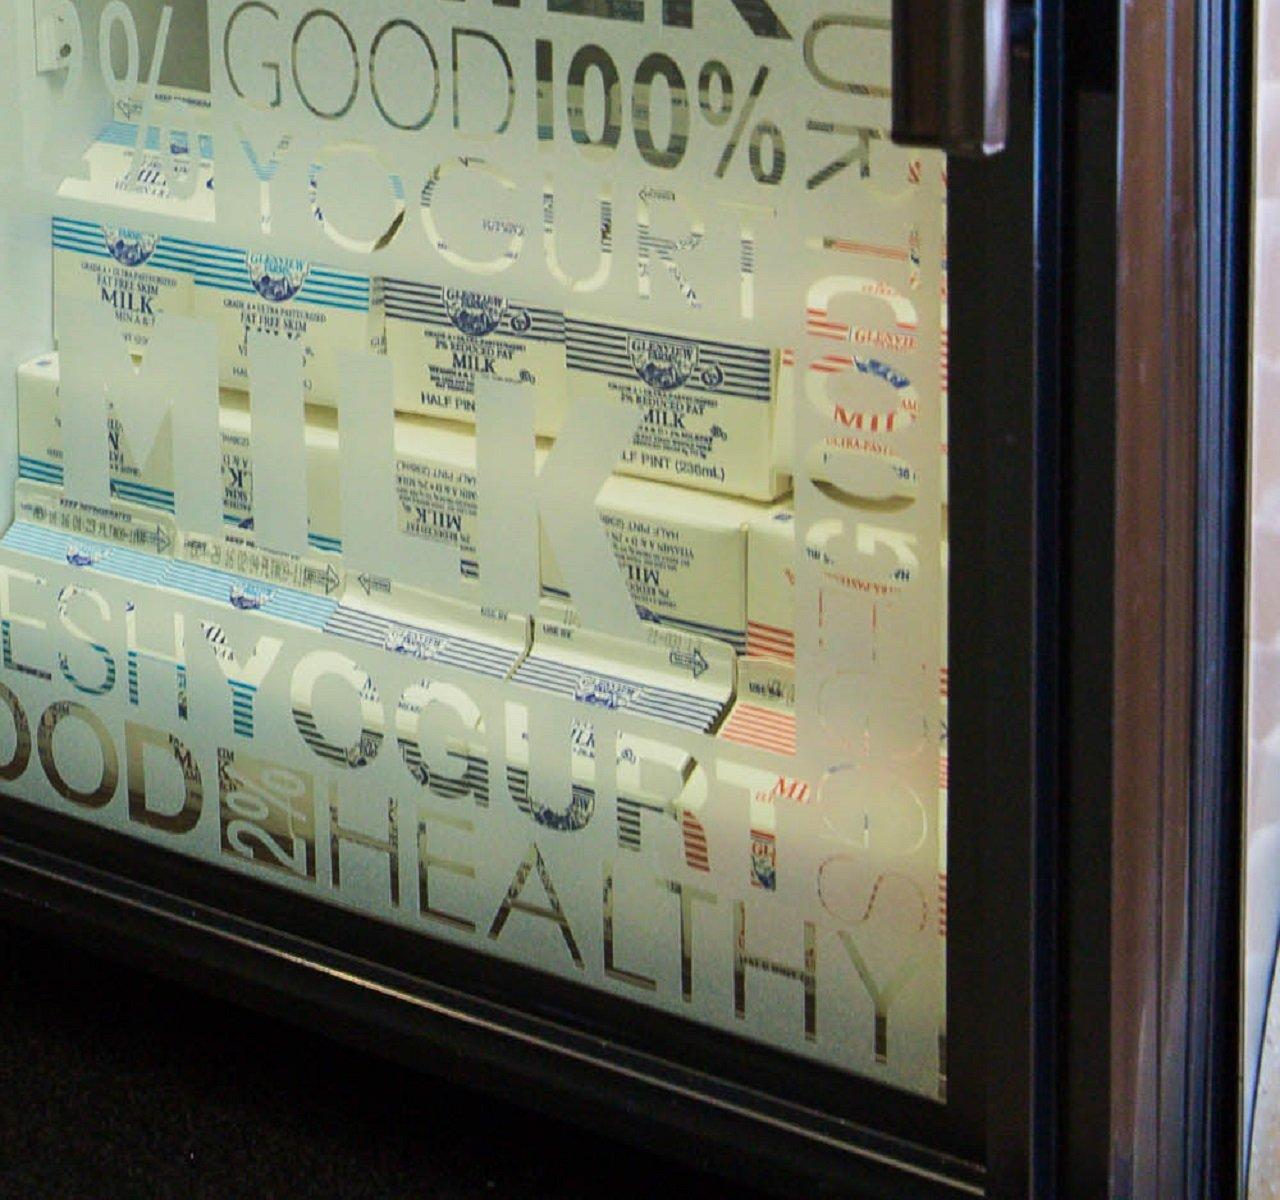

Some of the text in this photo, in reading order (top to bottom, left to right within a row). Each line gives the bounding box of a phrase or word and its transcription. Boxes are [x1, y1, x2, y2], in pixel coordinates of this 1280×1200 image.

[222, 0, 787, 186] GOOD 100%
[236, 122, 778, 320] YOGURT
[96, 274, 159, 296] FAT FREE SKIM
[101, 287, 154, 314] MILK
[240, 311, 307, 333] FAT FREE SKIM
[630, 339, 693, 359] GLENVIEW
[452, 352, 496, 373] MILK
[420, 390, 449, 408] HALF
[635, 393, 683, 412] REDUCED
[685, 403, 705, 417] FAT
[640, 452, 670, 470] PINT
[416, 507, 462, 532] MILK
[199, 618, 813, 892] YOGURT
[328, 777, 907, 1064] HEALTHY
